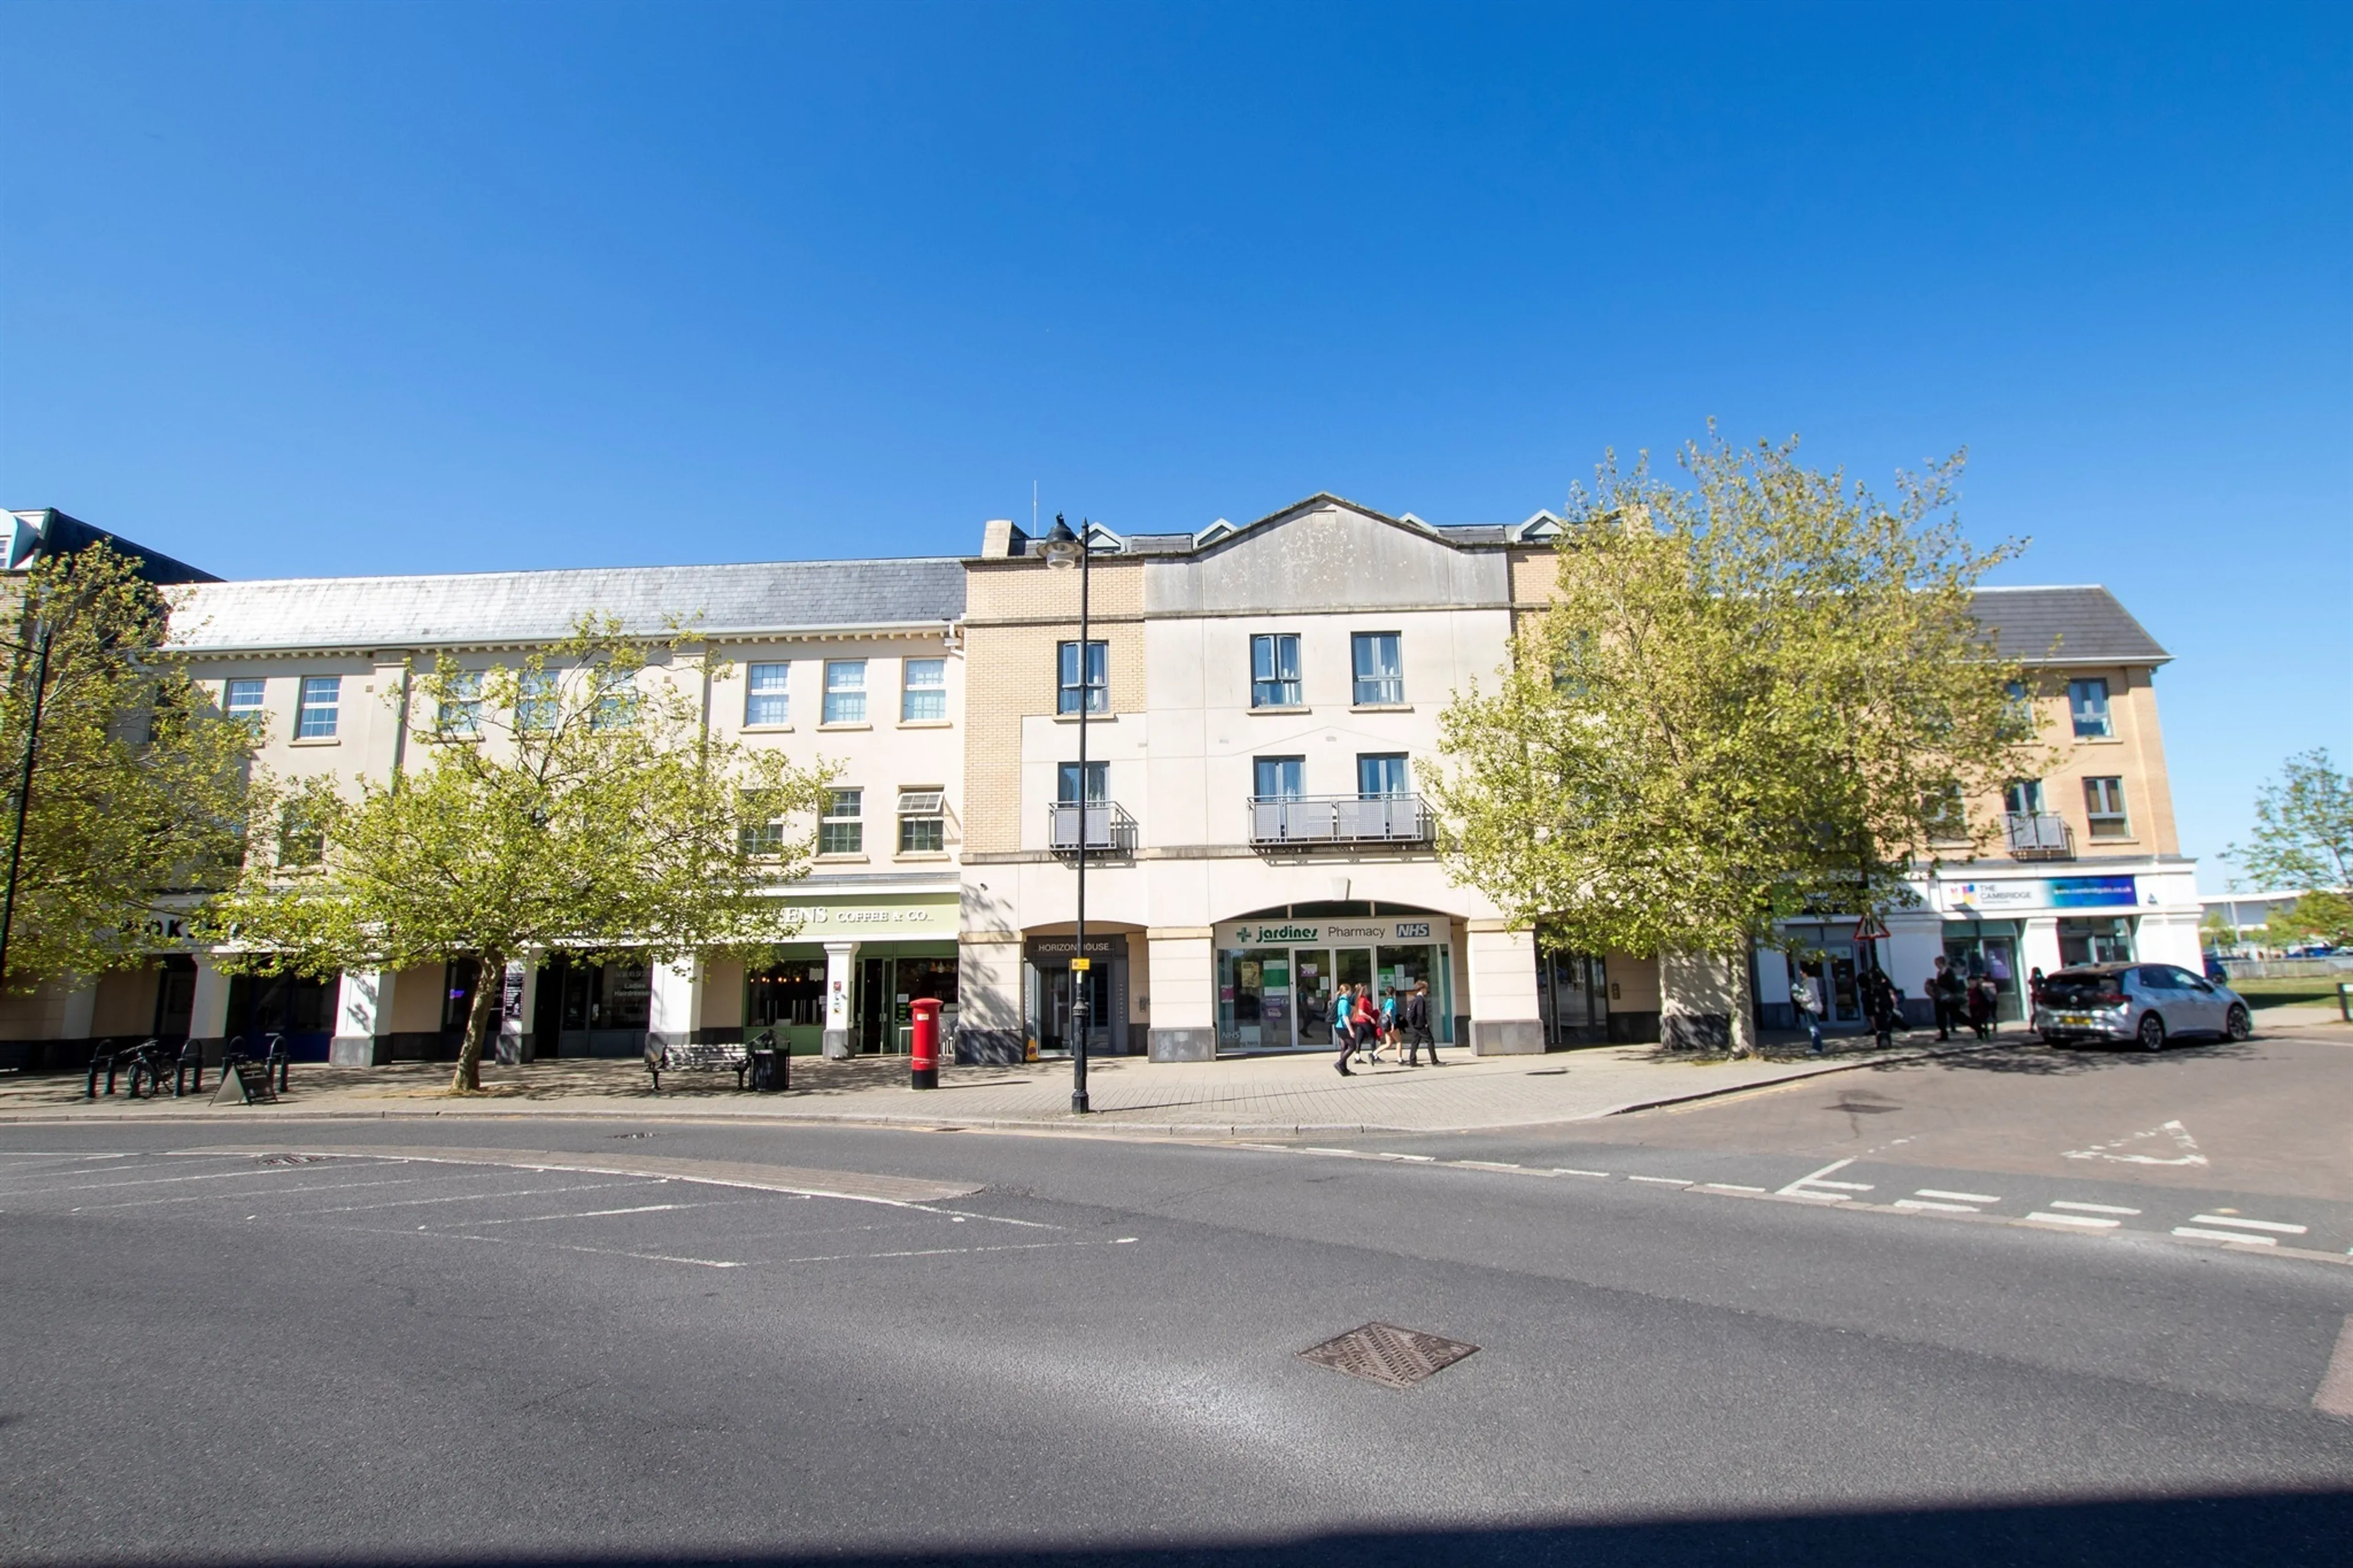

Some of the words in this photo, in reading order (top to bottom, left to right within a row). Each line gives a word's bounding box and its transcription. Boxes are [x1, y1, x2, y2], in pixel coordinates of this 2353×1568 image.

[837, 911, 889, 923] COFFEE
[892, 911, 904, 922] &
[1256, 925, 1318, 942] jardines
[1328, 926, 1385, 938] Pharmacy
[1398, 924, 1428, 937] NHS
[1221, 1031, 1240, 1039] NHS
